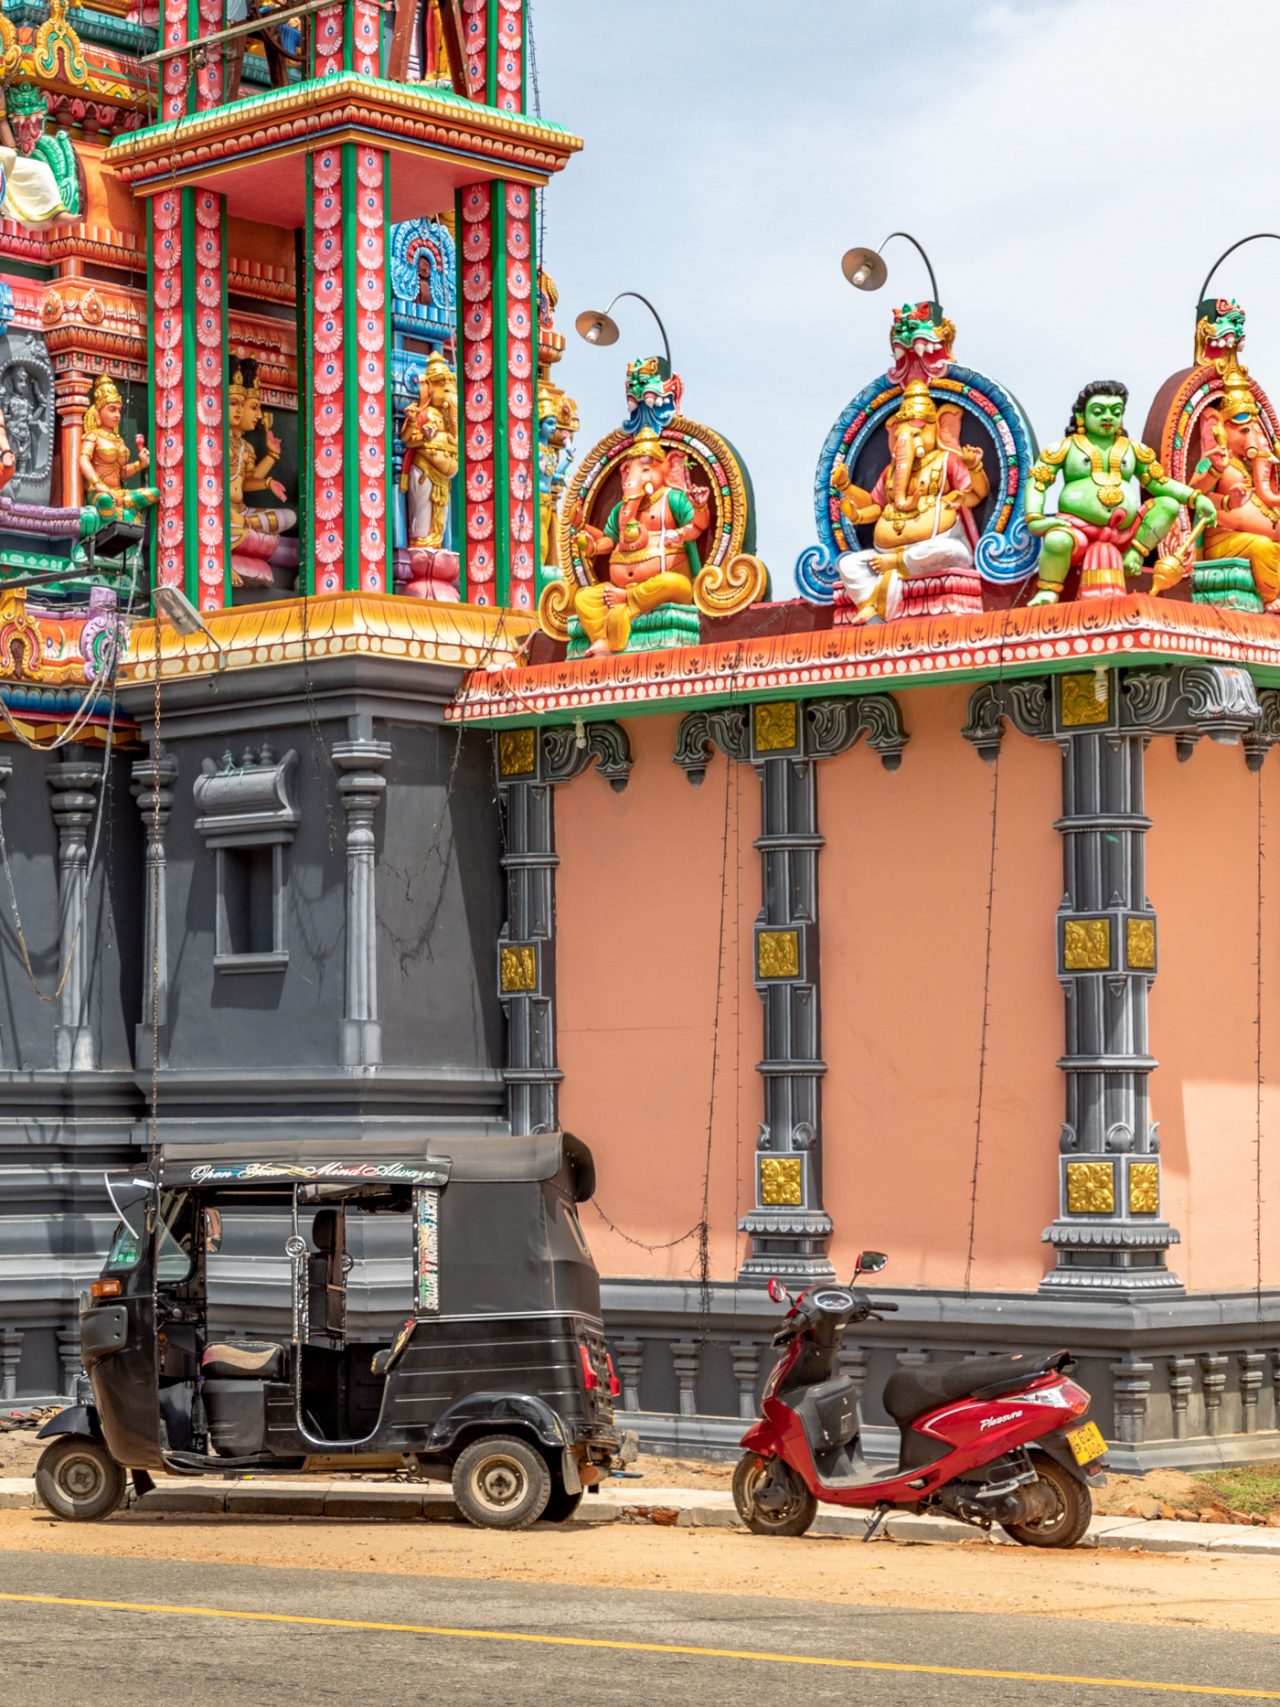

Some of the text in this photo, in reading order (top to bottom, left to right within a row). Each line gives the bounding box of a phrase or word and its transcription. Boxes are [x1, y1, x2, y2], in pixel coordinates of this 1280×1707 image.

[191, 1161, 437, 1184] Open Your Mind Always
[425, 1190, 439, 1310] LUCKY CUSHION & MOTORS
[980, 1409, 1024, 1432] Pleasure
